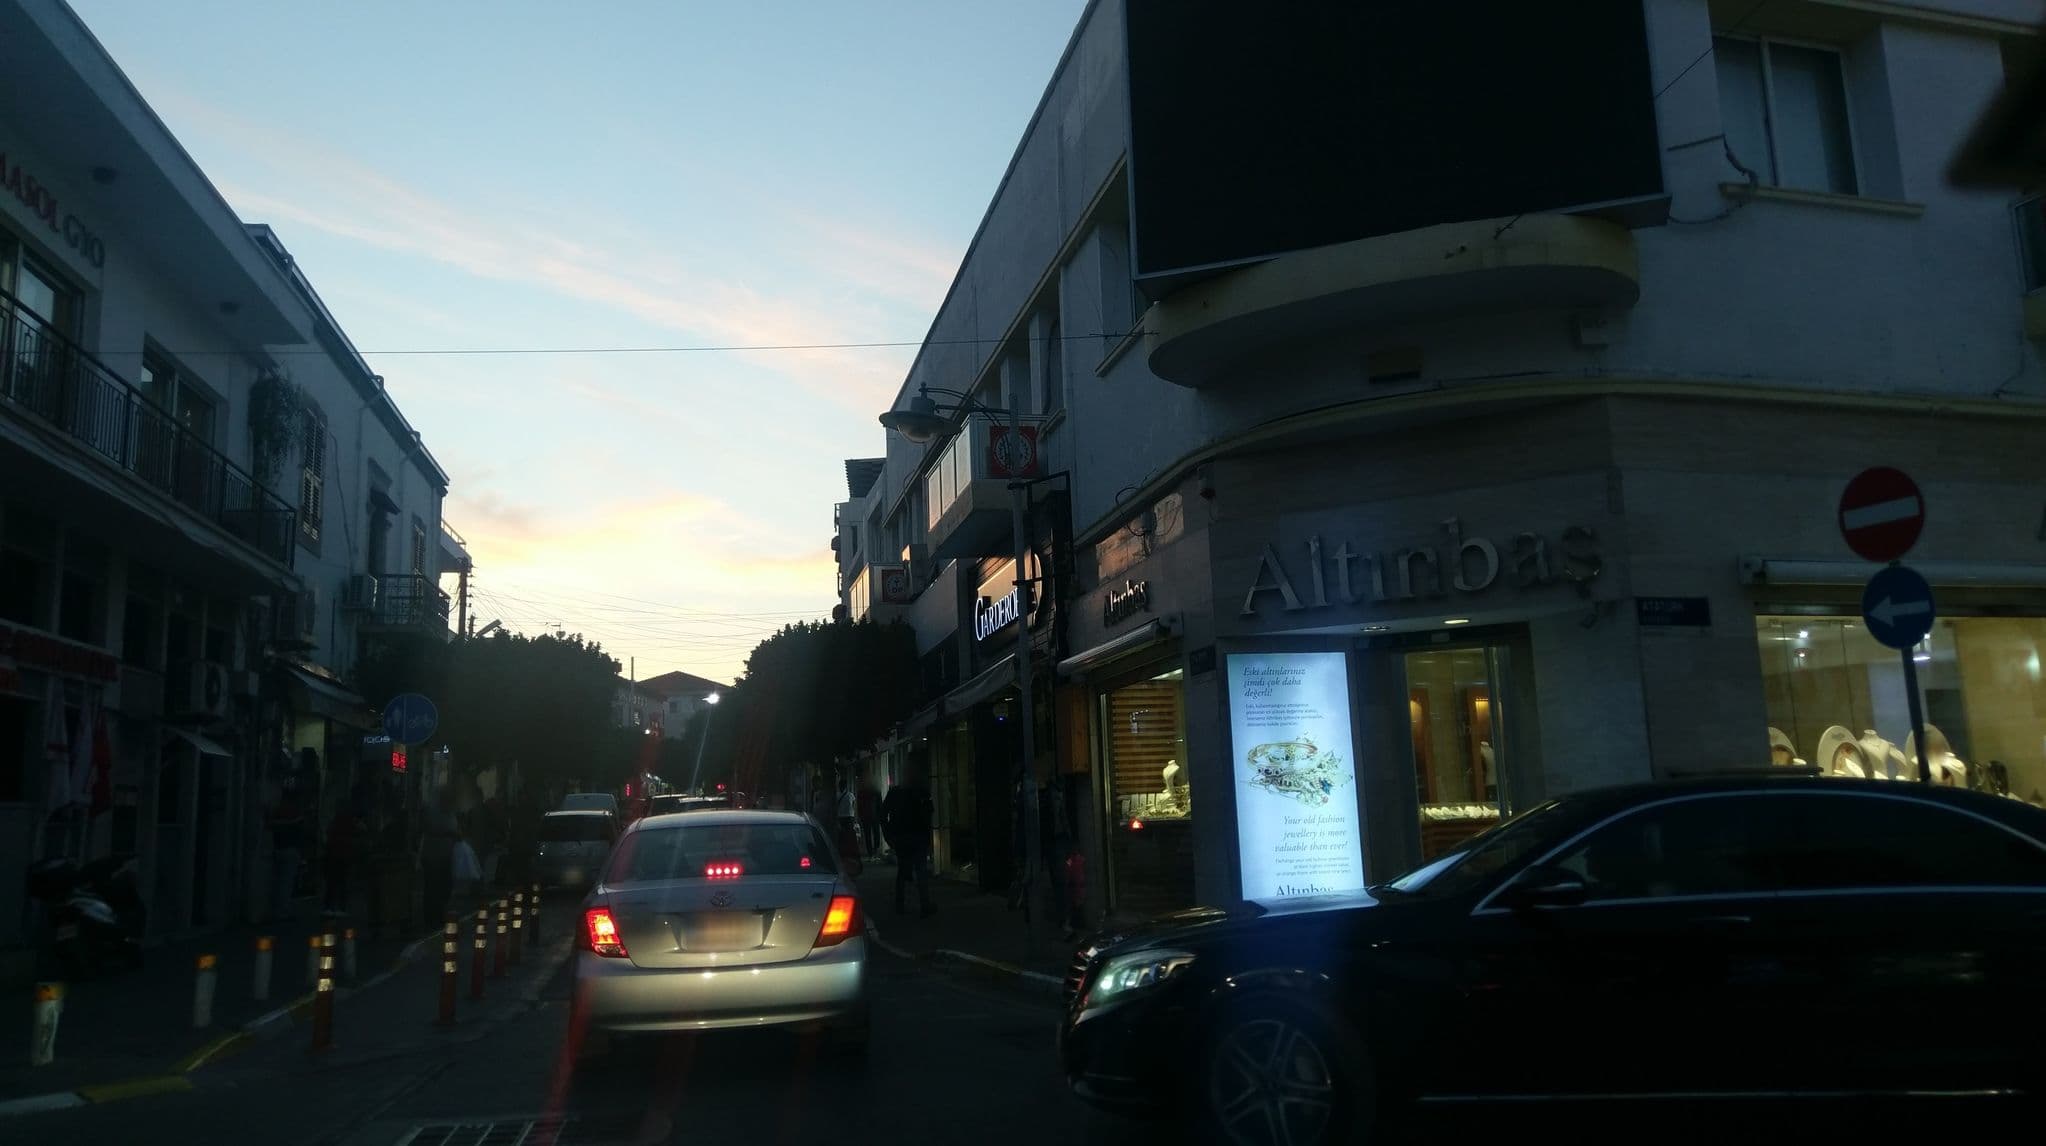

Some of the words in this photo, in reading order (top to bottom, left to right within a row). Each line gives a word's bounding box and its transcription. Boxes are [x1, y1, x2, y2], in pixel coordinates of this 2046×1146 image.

[0, 152, 60, 232] ASOL
[975, 584, 1036, 641] GARDERO
[1266, 677, 1281, 688] çok
[1282, 677, 1302, 686] daha
[1283, 816, 1301, 825] Your
[1303, 815, 1316, 824] old
[1317, 814, 1345, 826] fashion
[1283, 828, 1317, 840] jewellery
[1319, 829, 1325, 838] is
[1327, 829, 1347, 838] more
[1275, 842, 1307, 852] valuable
[1310, 841, 1328, 851] than
[1330, 840, 1348, 850] ever!
